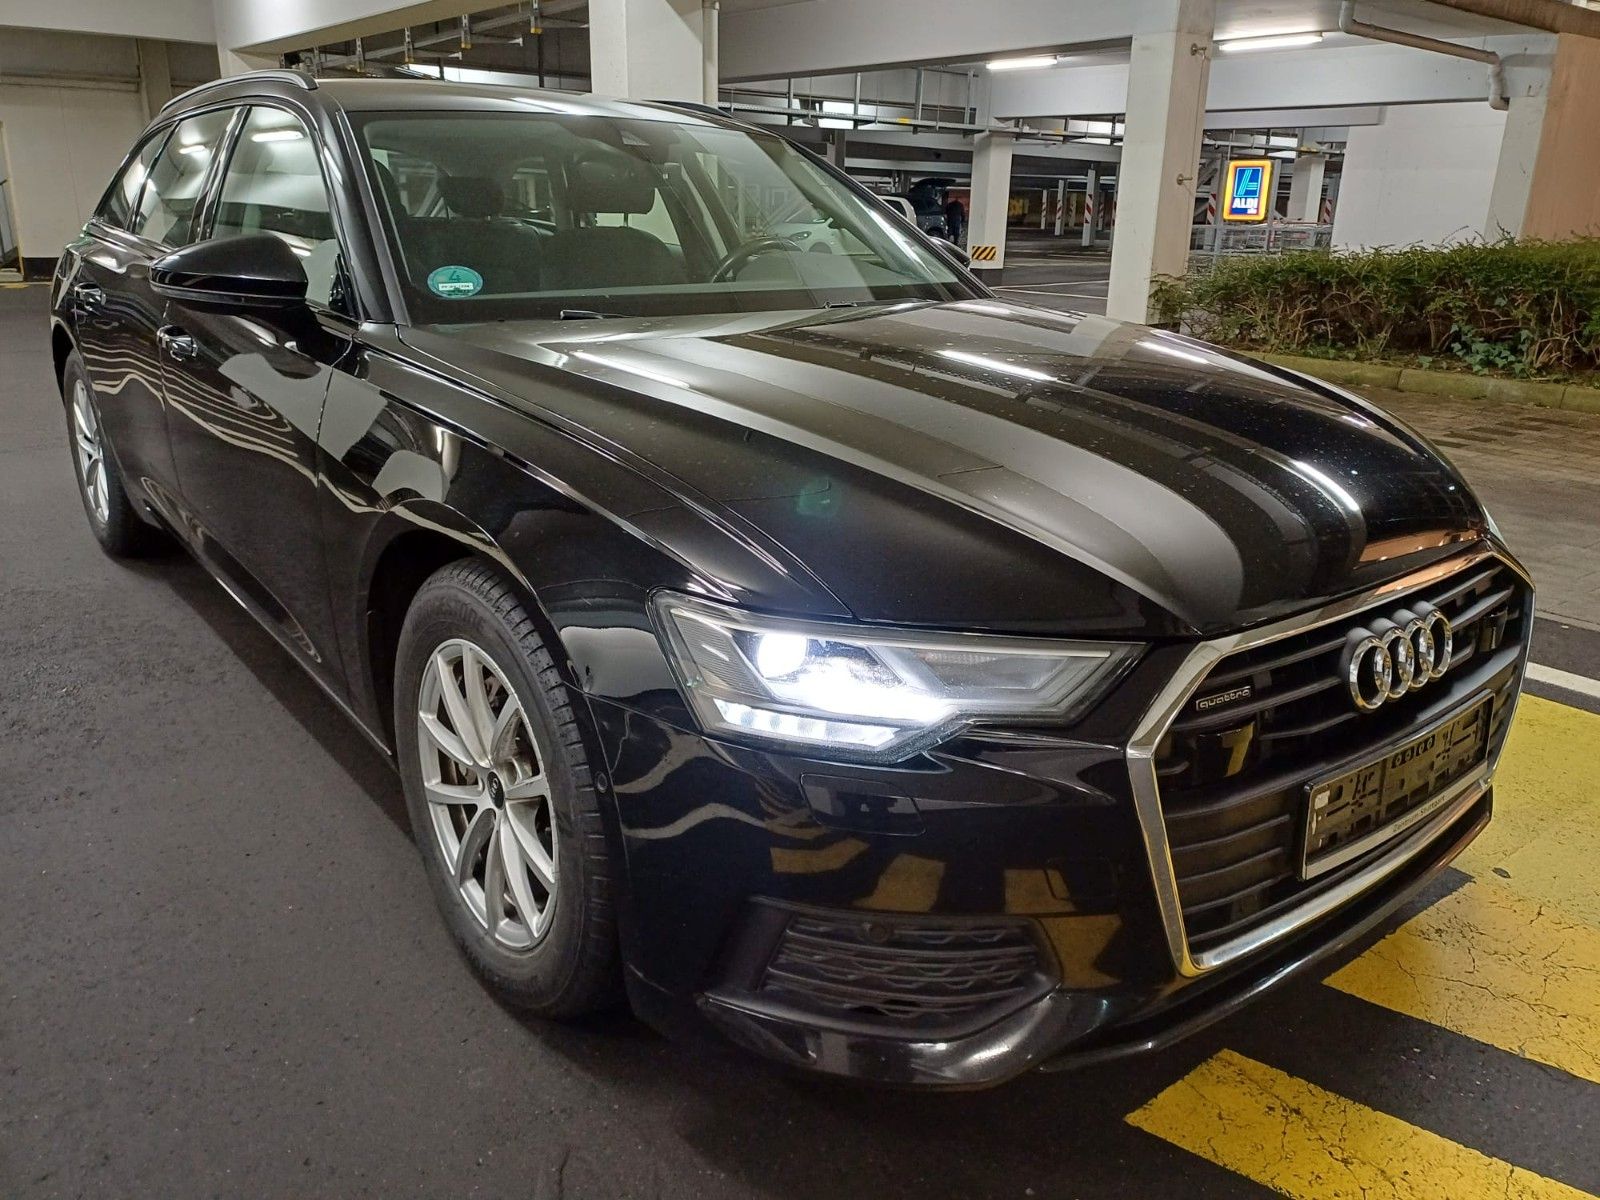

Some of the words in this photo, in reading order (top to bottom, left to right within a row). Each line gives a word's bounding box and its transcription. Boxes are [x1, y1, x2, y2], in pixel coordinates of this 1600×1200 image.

[1232, 197, 1259, 209] ALDI
[449, 270, 461, 283] 4
[1199, 689, 1251, 709] quattro
